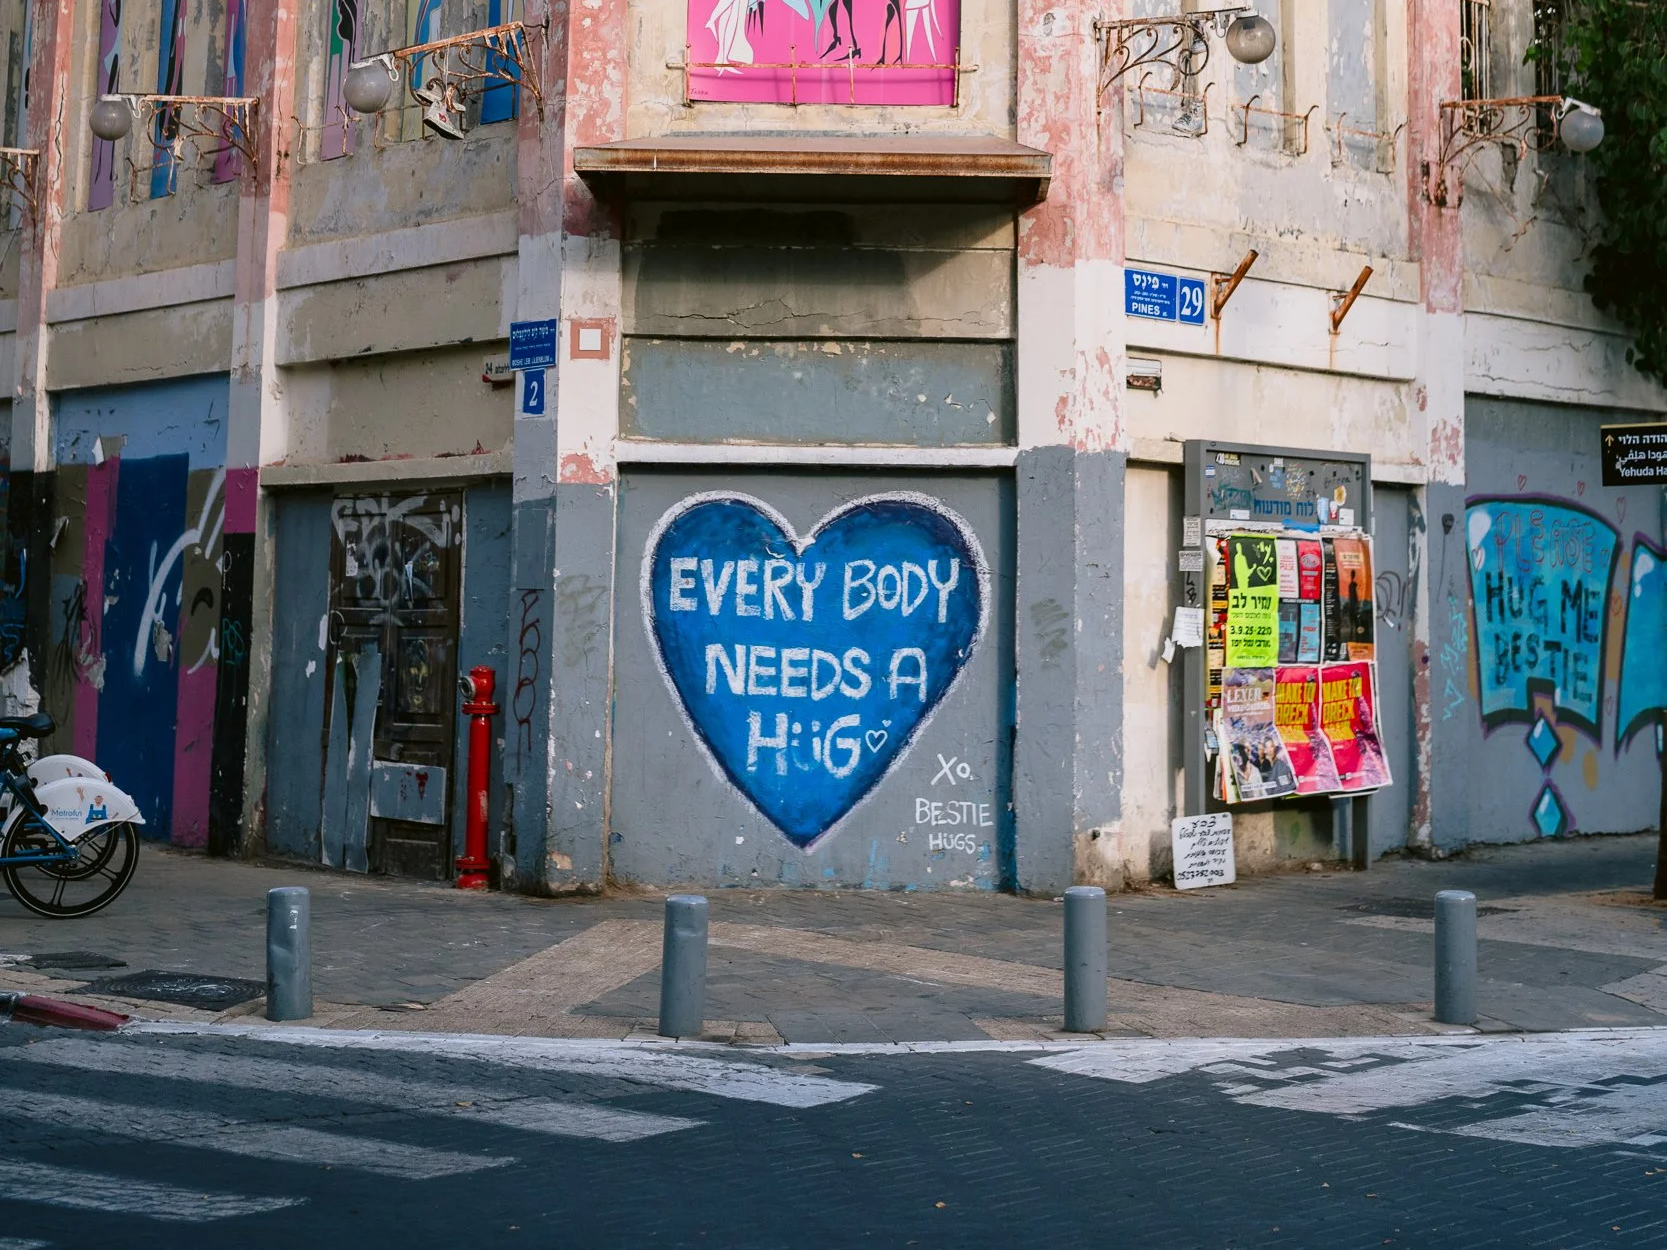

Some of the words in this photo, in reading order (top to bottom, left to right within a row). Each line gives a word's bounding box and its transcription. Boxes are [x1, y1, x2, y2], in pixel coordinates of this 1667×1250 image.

[1131, 302, 1160, 316] PINES
[1180, 286, 1203, 317] 29
[529, 381, 538, 406] 2
[1618, 434, 1640, 445] הלוי
[1642, 434, 1667, 444] הודה
[1620, 466, 1654, 477] Yehuda
[1656, 466, 1667, 476] Ha
[1253, 498, 1292, 516] מודעות
[1296, 500, 1314, 516] לוח
[1495, 510, 1596, 574] PLEASE
[669, 556, 826, 621] EVERY
[842, 558, 960, 623] BODY
[1231, 593, 1247, 609] לב
[1485, 572, 1549, 635] HUG
[1560, 579, 1600, 643] ME
[705, 644, 871, 701] NEEDS
[887, 647, 928, 702] A
[1494, 631, 1592, 701] BESTIE
[1275, 682, 1303, 703] MAKE
[1322, 679, 1348, 704] MAKE
[915, 798, 994, 826] BESTIE
